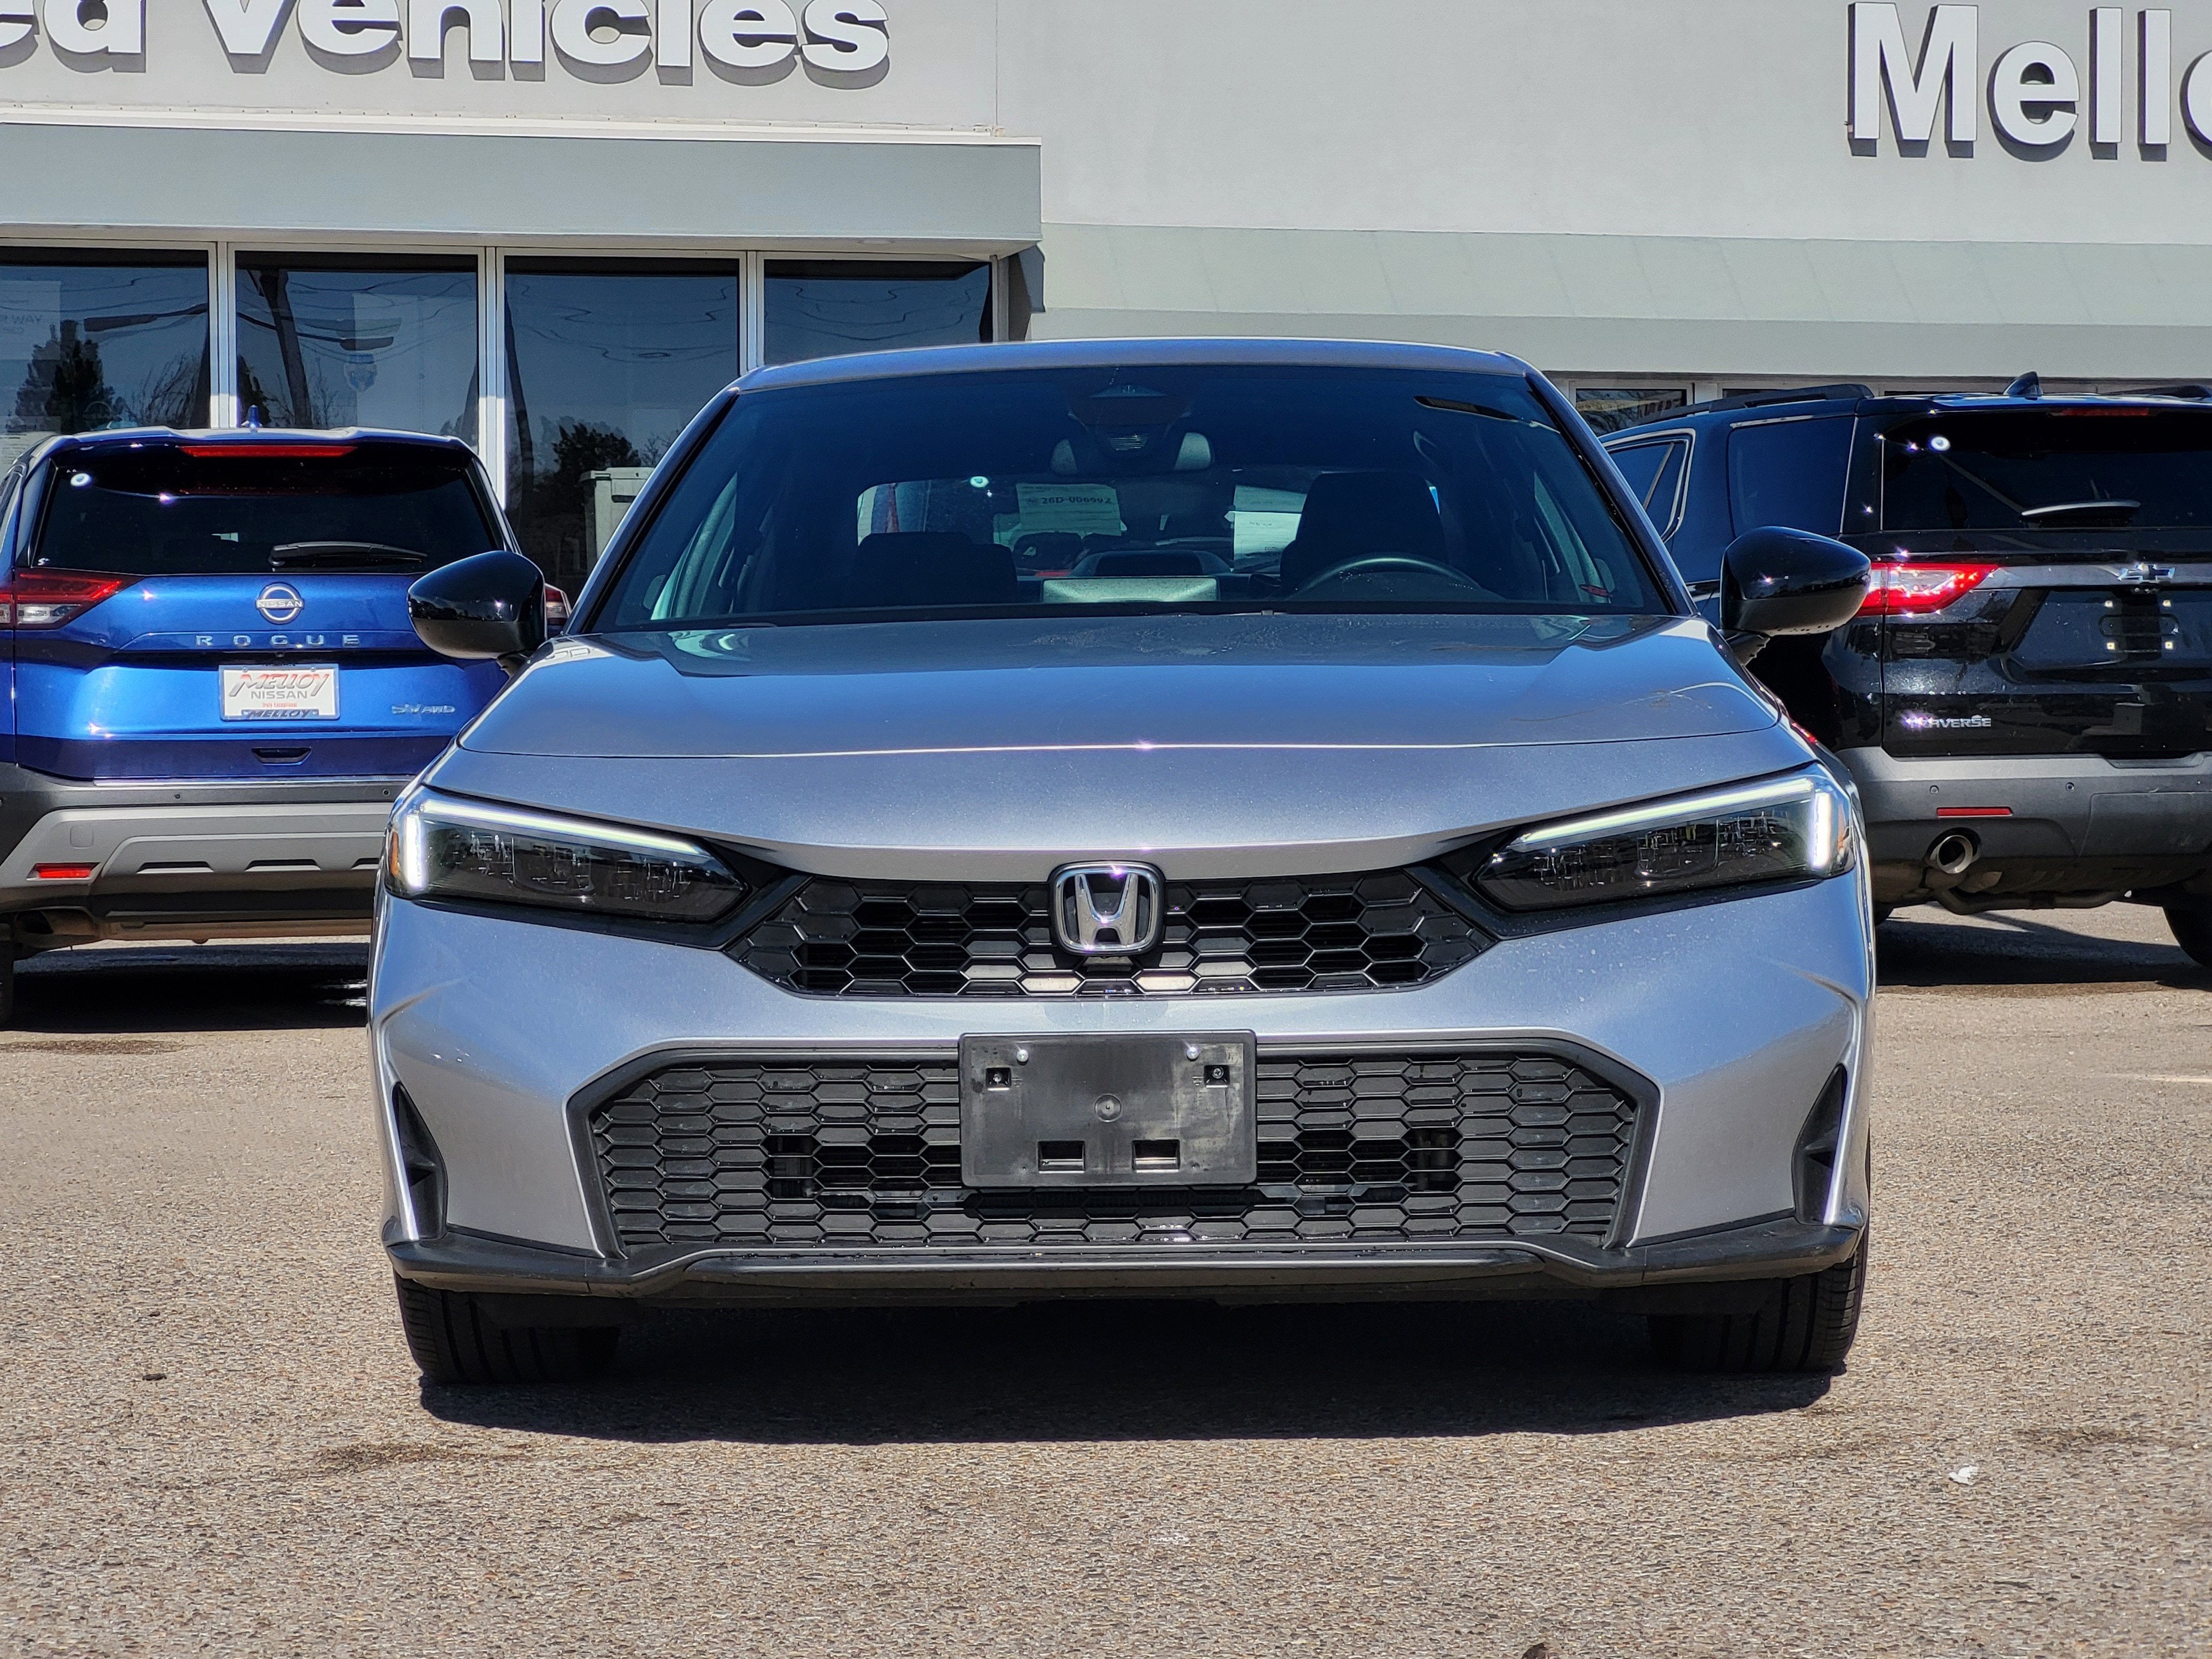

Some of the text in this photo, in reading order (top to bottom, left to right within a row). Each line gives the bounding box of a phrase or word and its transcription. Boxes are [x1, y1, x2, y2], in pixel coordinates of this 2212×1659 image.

[195, 634, 360, 646] ROGUE
[229, 673, 330, 697] MELLOY
[251, 690, 307, 700] NISSAN
[247, 709, 311, 718] MELLOY
